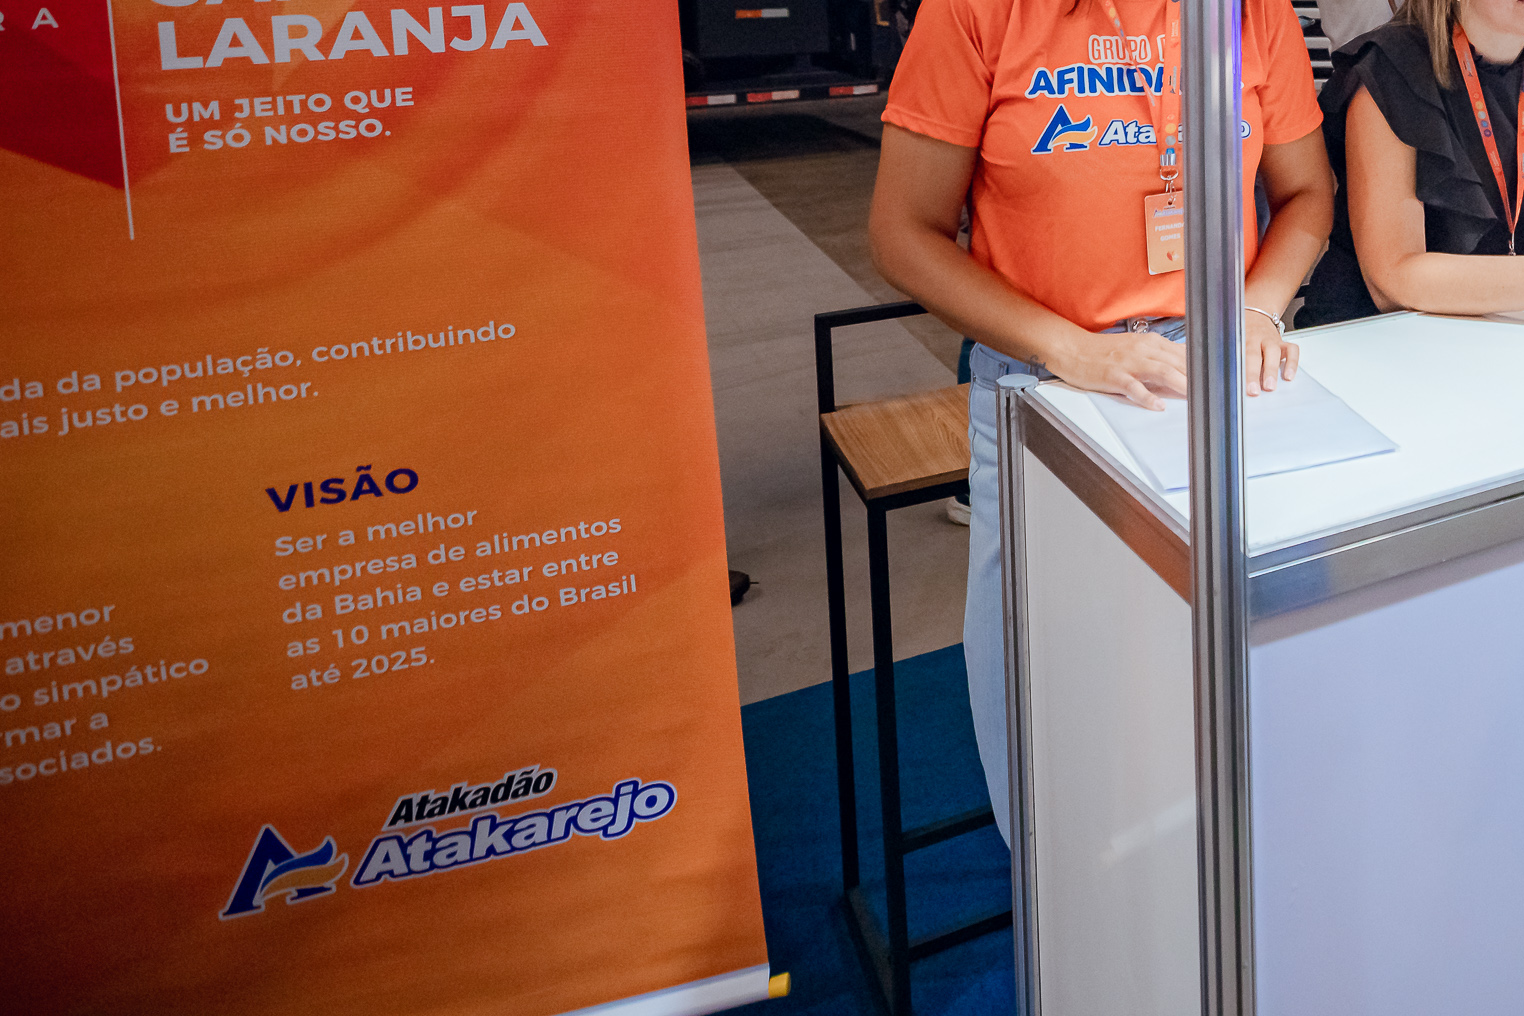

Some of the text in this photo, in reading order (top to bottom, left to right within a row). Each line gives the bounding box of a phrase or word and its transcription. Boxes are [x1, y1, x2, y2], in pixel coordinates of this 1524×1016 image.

[156, 2, 549, 71] LARANJA
[1089, 34, 1151, 64] GRUPO
[164, 87, 415, 124] UM JEITO QUE
[168, 117, 392, 153] É SÓ NOSSO.
[57, 371, 102, 394] da
[114, 347, 302, 392] população,
[311, 321, 516, 363] contribuindo
[58, 403, 149, 436] justo
[160, 399, 179, 416] e
[191, 380, 319, 413] melhor.
[265, 464, 420, 513] VISÃO
[274, 509, 478, 557] Ser a melhor
[278, 516, 622, 591] empresa de alimentos
[282, 550, 620, 625] da Bahia e estar entre
[0, 604, 116, 639] menor
[286, 575, 638, 658] as 10 maiores do Brasil
[5, 635, 135, 676] através
[291, 646, 436, 691] até 2025.
[33, 658, 210, 706] simpático
[4, 712, 109, 748] mar a
[0, 736, 162, 784] sociados.
[386, 768, 555, 829] Atakadão
[353, 780, 675, 886] Atakarejo
